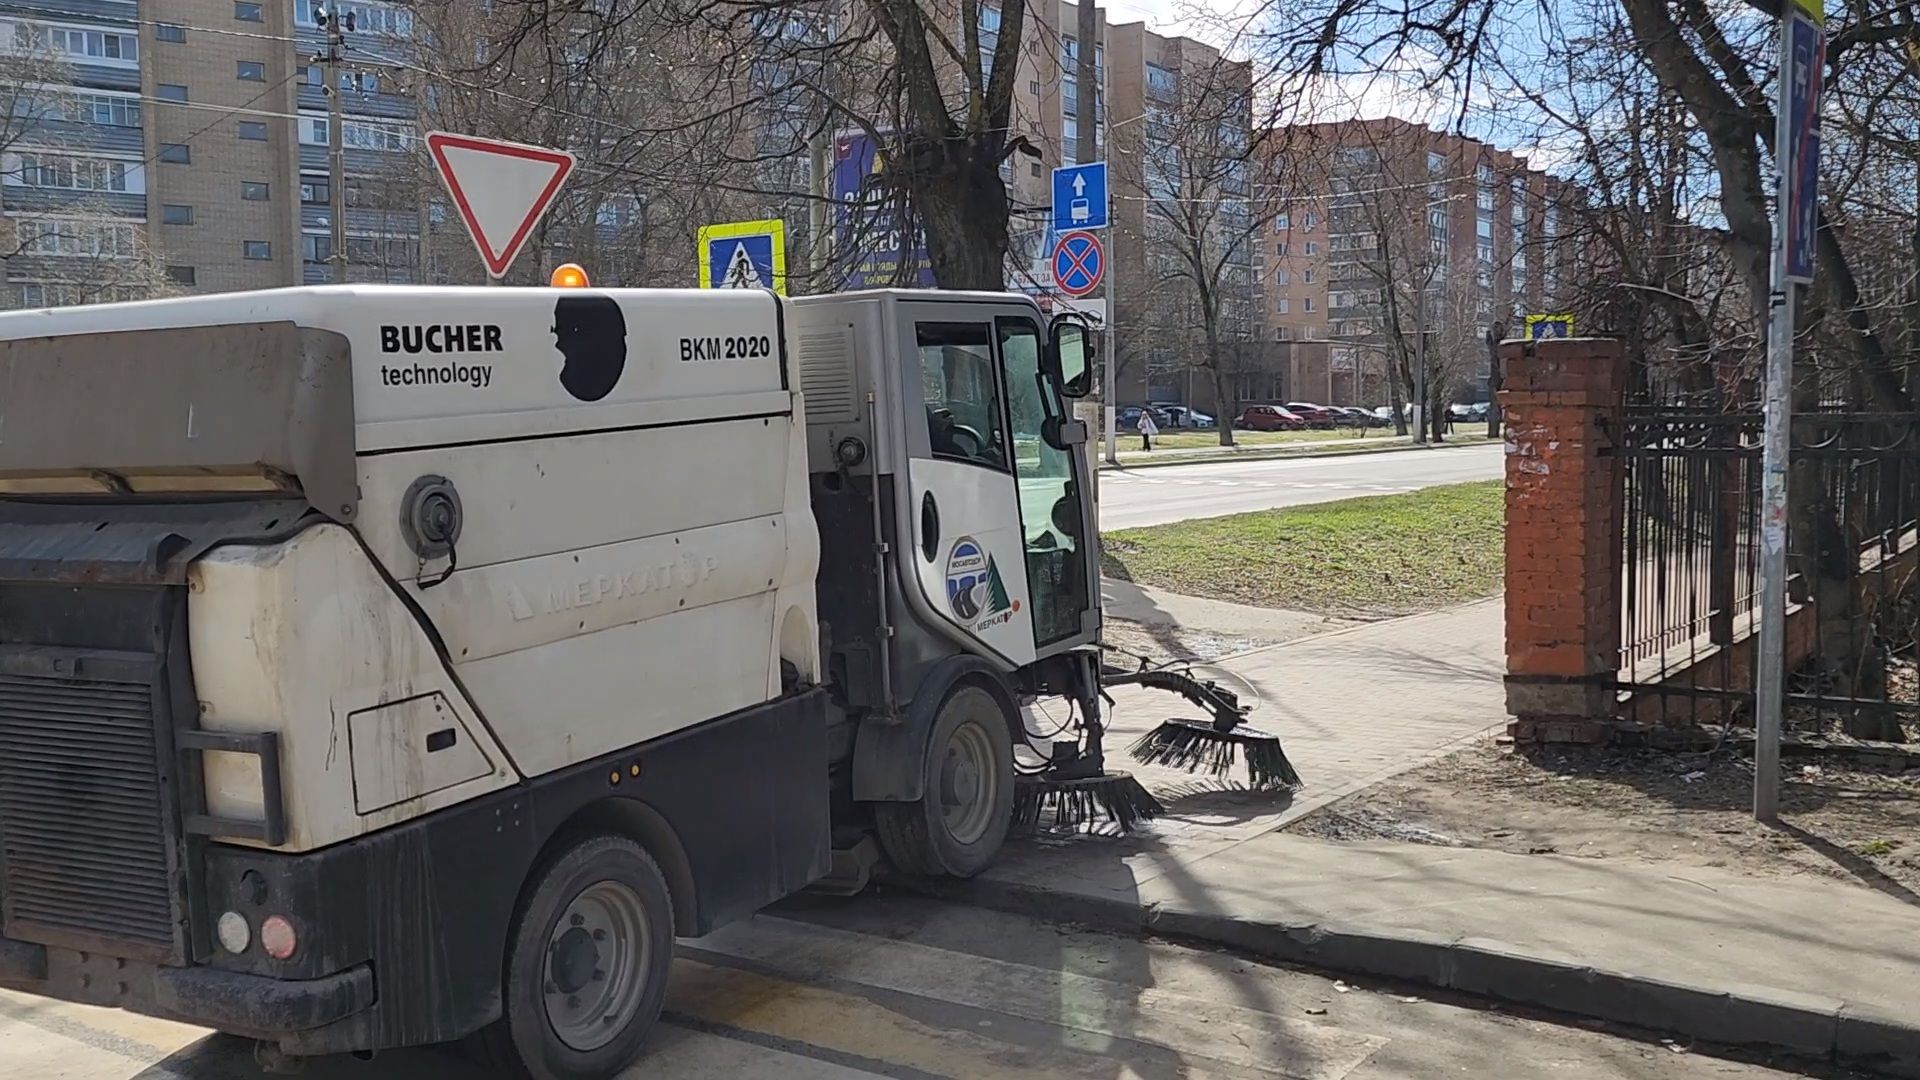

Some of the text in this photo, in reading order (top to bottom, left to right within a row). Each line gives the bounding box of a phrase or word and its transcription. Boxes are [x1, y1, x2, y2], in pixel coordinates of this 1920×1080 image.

[380, 325, 503, 353] BUCHER
[680, 336, 770, 361] BKM 2020
[381, 361, 492, 388] technology
